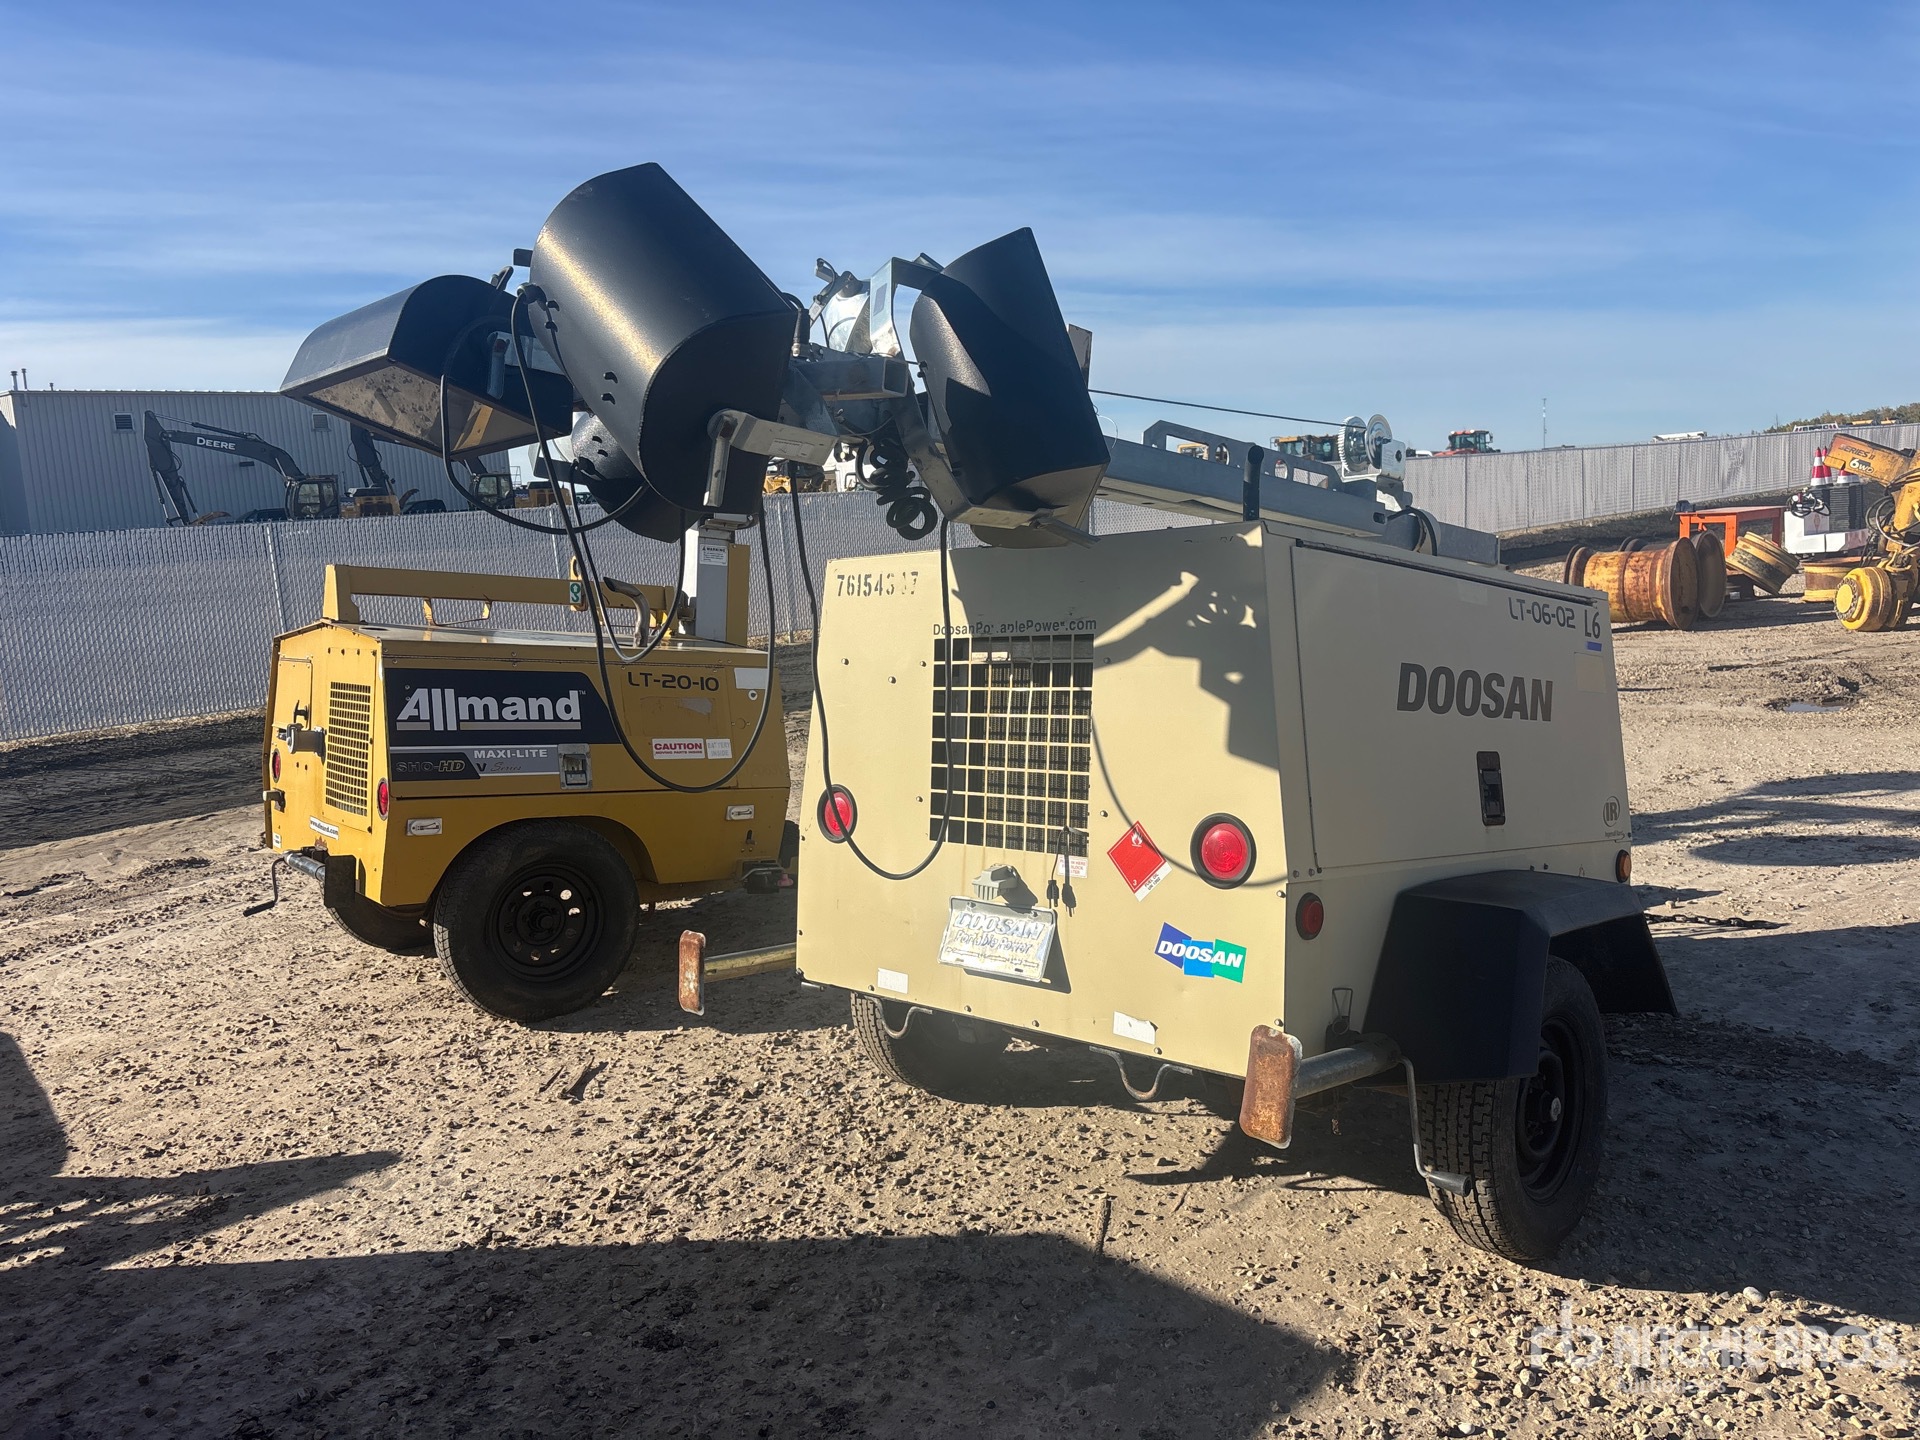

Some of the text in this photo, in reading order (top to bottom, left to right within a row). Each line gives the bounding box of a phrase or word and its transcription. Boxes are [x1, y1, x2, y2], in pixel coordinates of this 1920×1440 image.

[196, 436, 236, 450] DEERE
[1839, 444, 1870, 458] SERIES
[1508, 597, 1576, 629] LT-06-02
[933, 619, 1097, 636] DoosanPoablePowe.com
[628, 672, 719, 692] LT-20-10
[1397, 662, 1553, 722] DOOSAN
[396, 688, 582, 731] Allmand
[474, 749, 548, 759] MAXI-LITE
[654, 742, 702, 750] CAUTION
[396, 760, 465, 772] SHO-HD
[490, 761, 522, 772] Series
[1132, 879, 1138, 887] 3
[953, 911, 1046, 940] DOOSAN
[955, 929, 999, 949] Portable
[1158, 940, 1243, 968] DOOSAN
